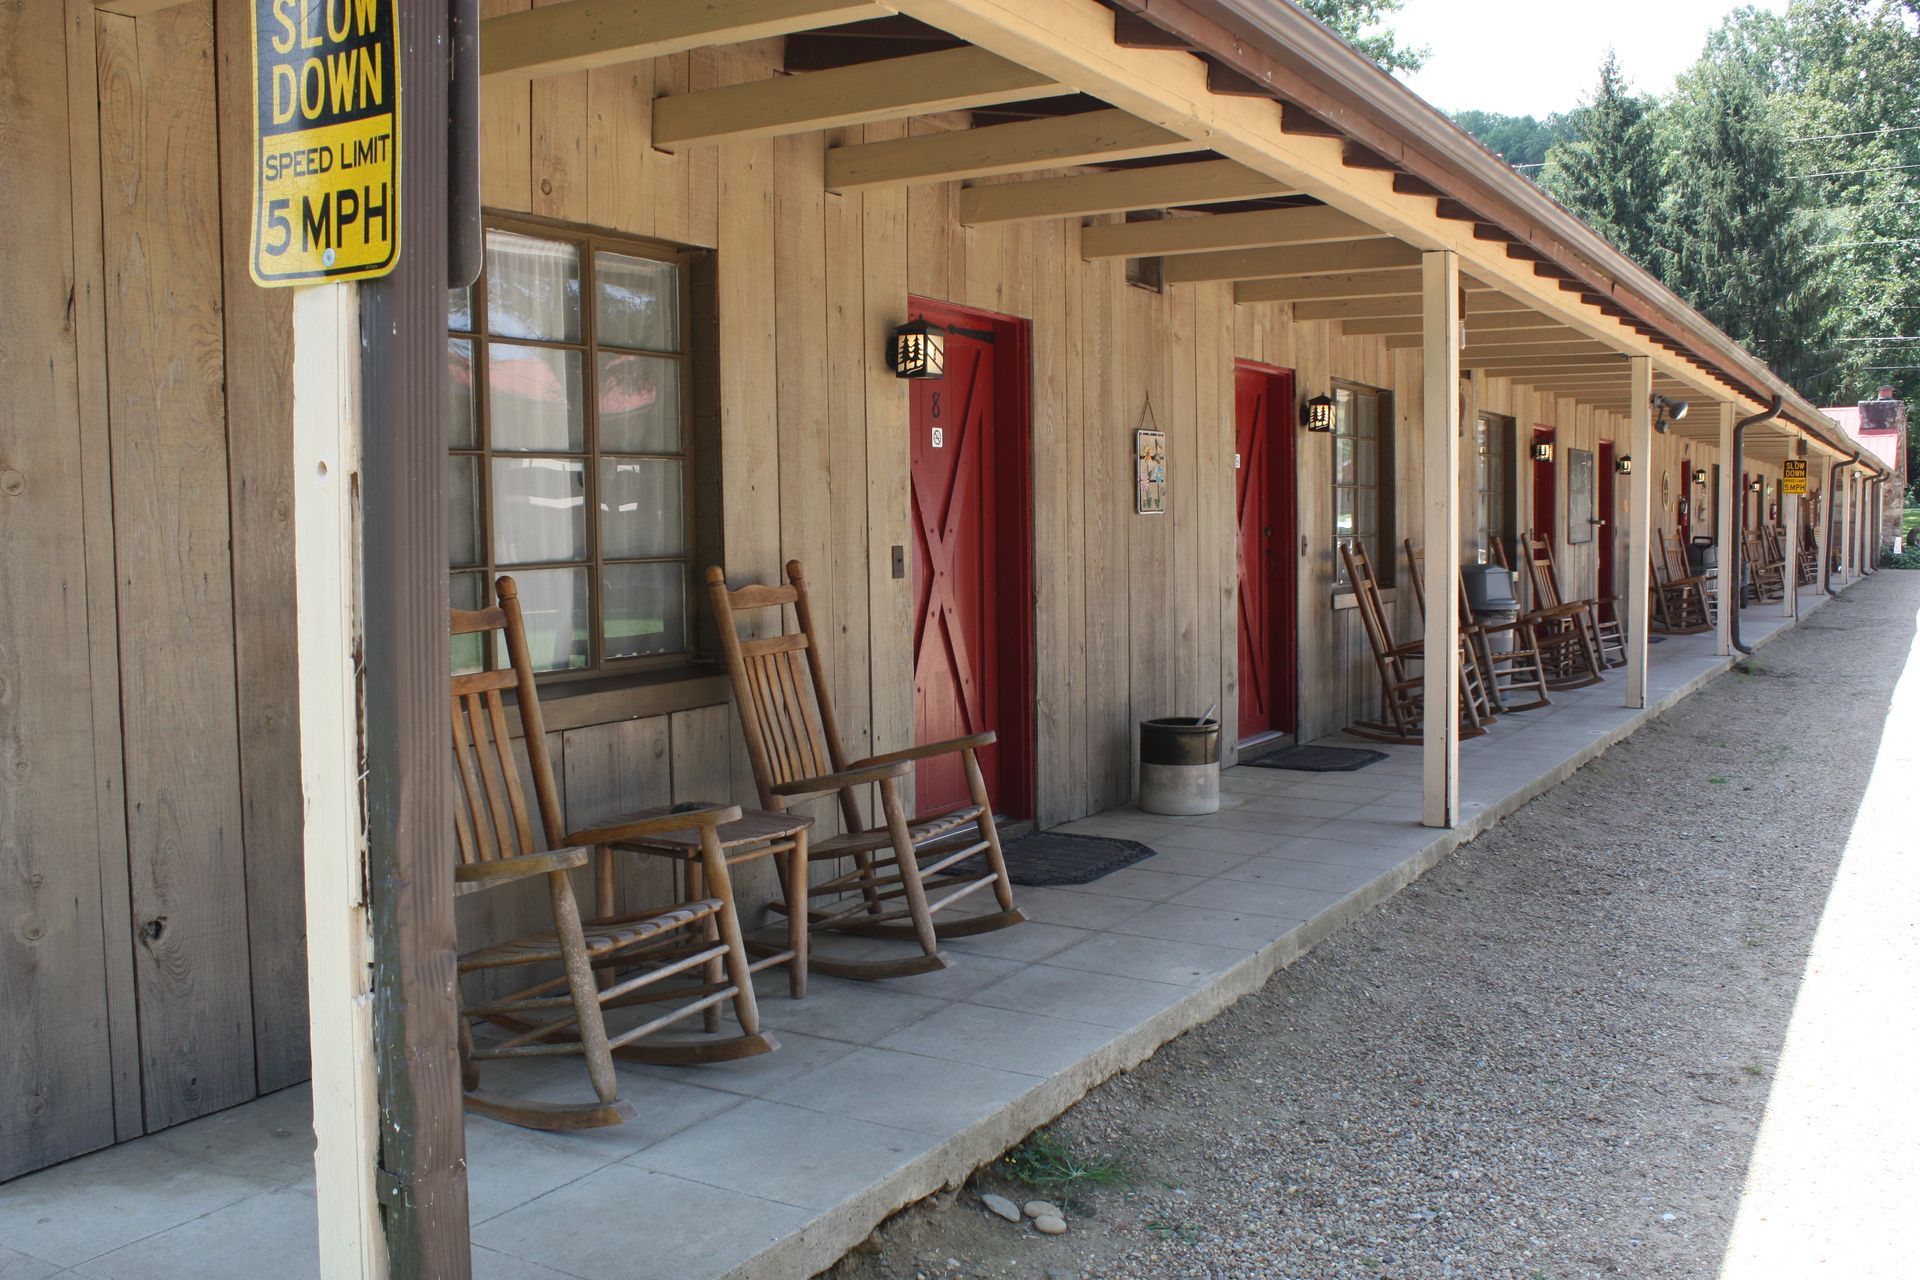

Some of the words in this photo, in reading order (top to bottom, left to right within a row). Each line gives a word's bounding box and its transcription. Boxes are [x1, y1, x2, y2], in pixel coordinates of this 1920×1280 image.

[272, 0, 377, 54] SLOW
[272, 42, 382, 125] DOWN
[265, 145, 334, 182] SPEED
[340, 134, 390, 170] LIMIT
[264, 198, 292, 257] 5
[302, 182, 387, 253] MPH
[932, 391, 940, 417] 8
